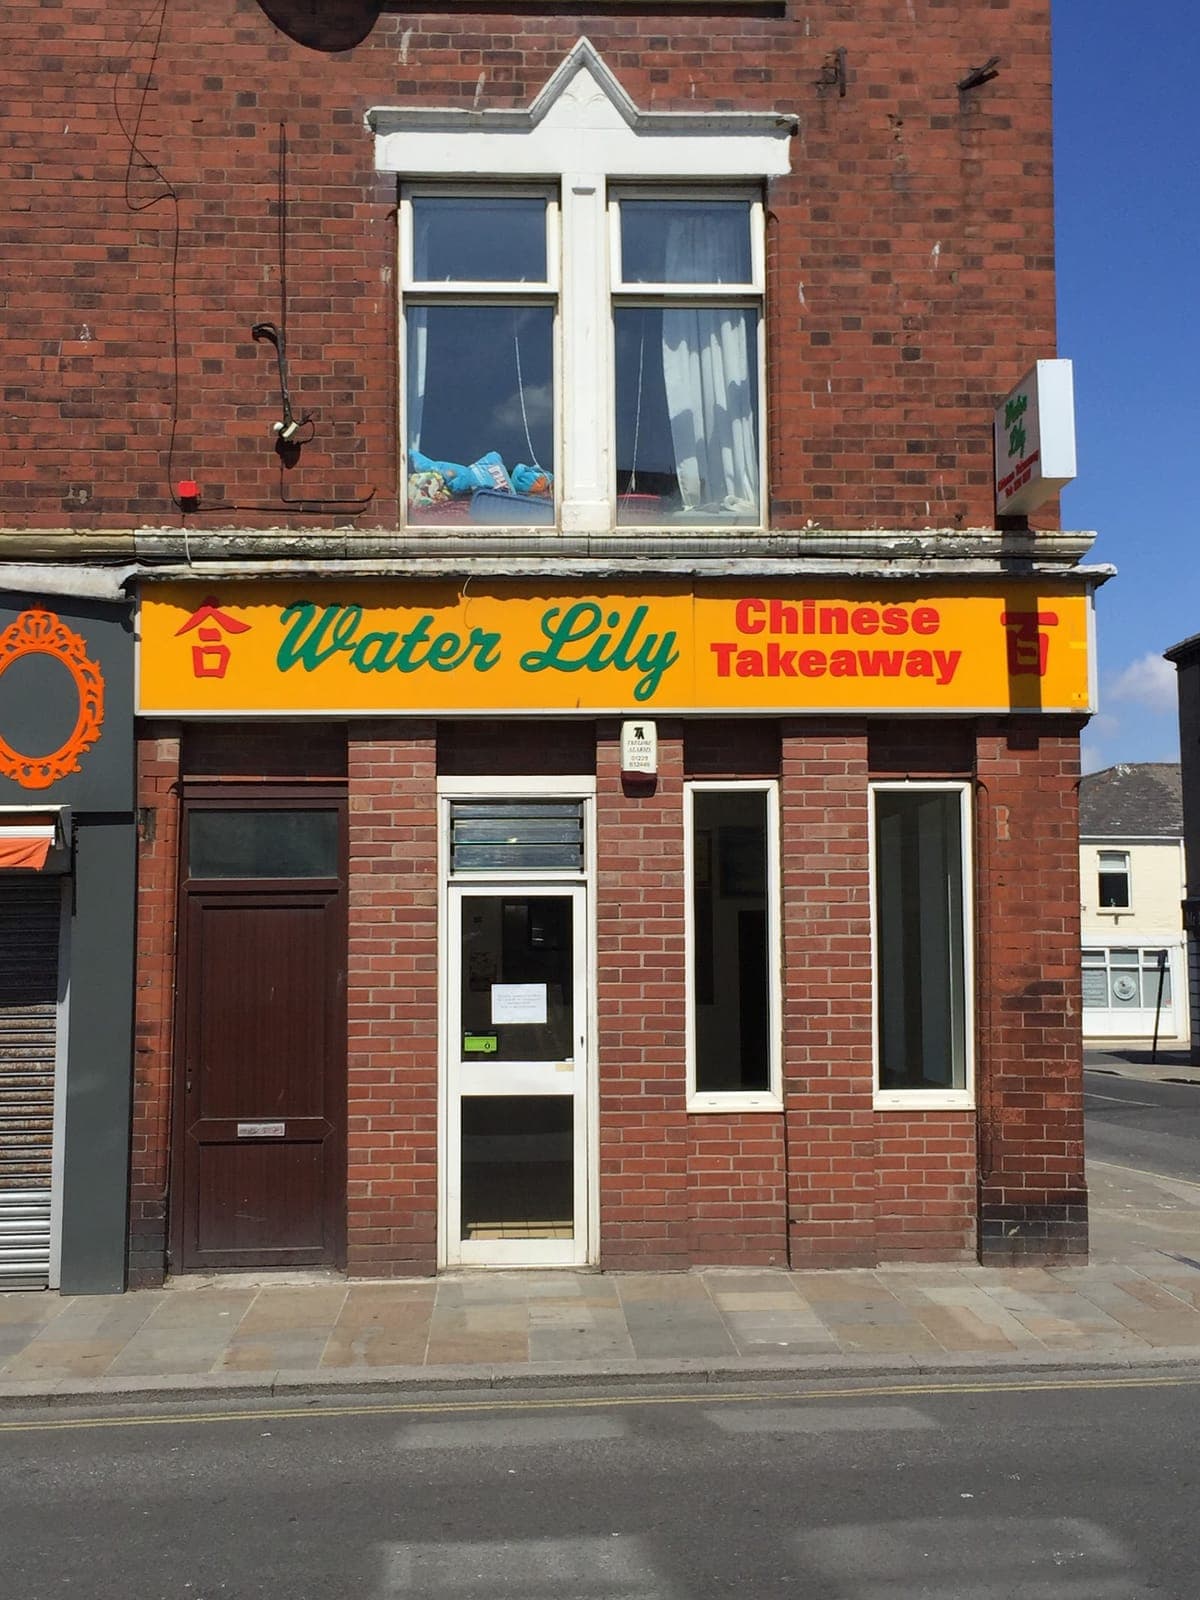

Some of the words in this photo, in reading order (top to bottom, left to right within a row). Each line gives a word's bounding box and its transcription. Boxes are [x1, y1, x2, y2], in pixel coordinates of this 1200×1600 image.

[735, 599, 940, 635] Chinese
[276, 600, 501, 673] Water
[519, 602, 680, 702] Lily
[710, 643, 962, 685] Takeaway
